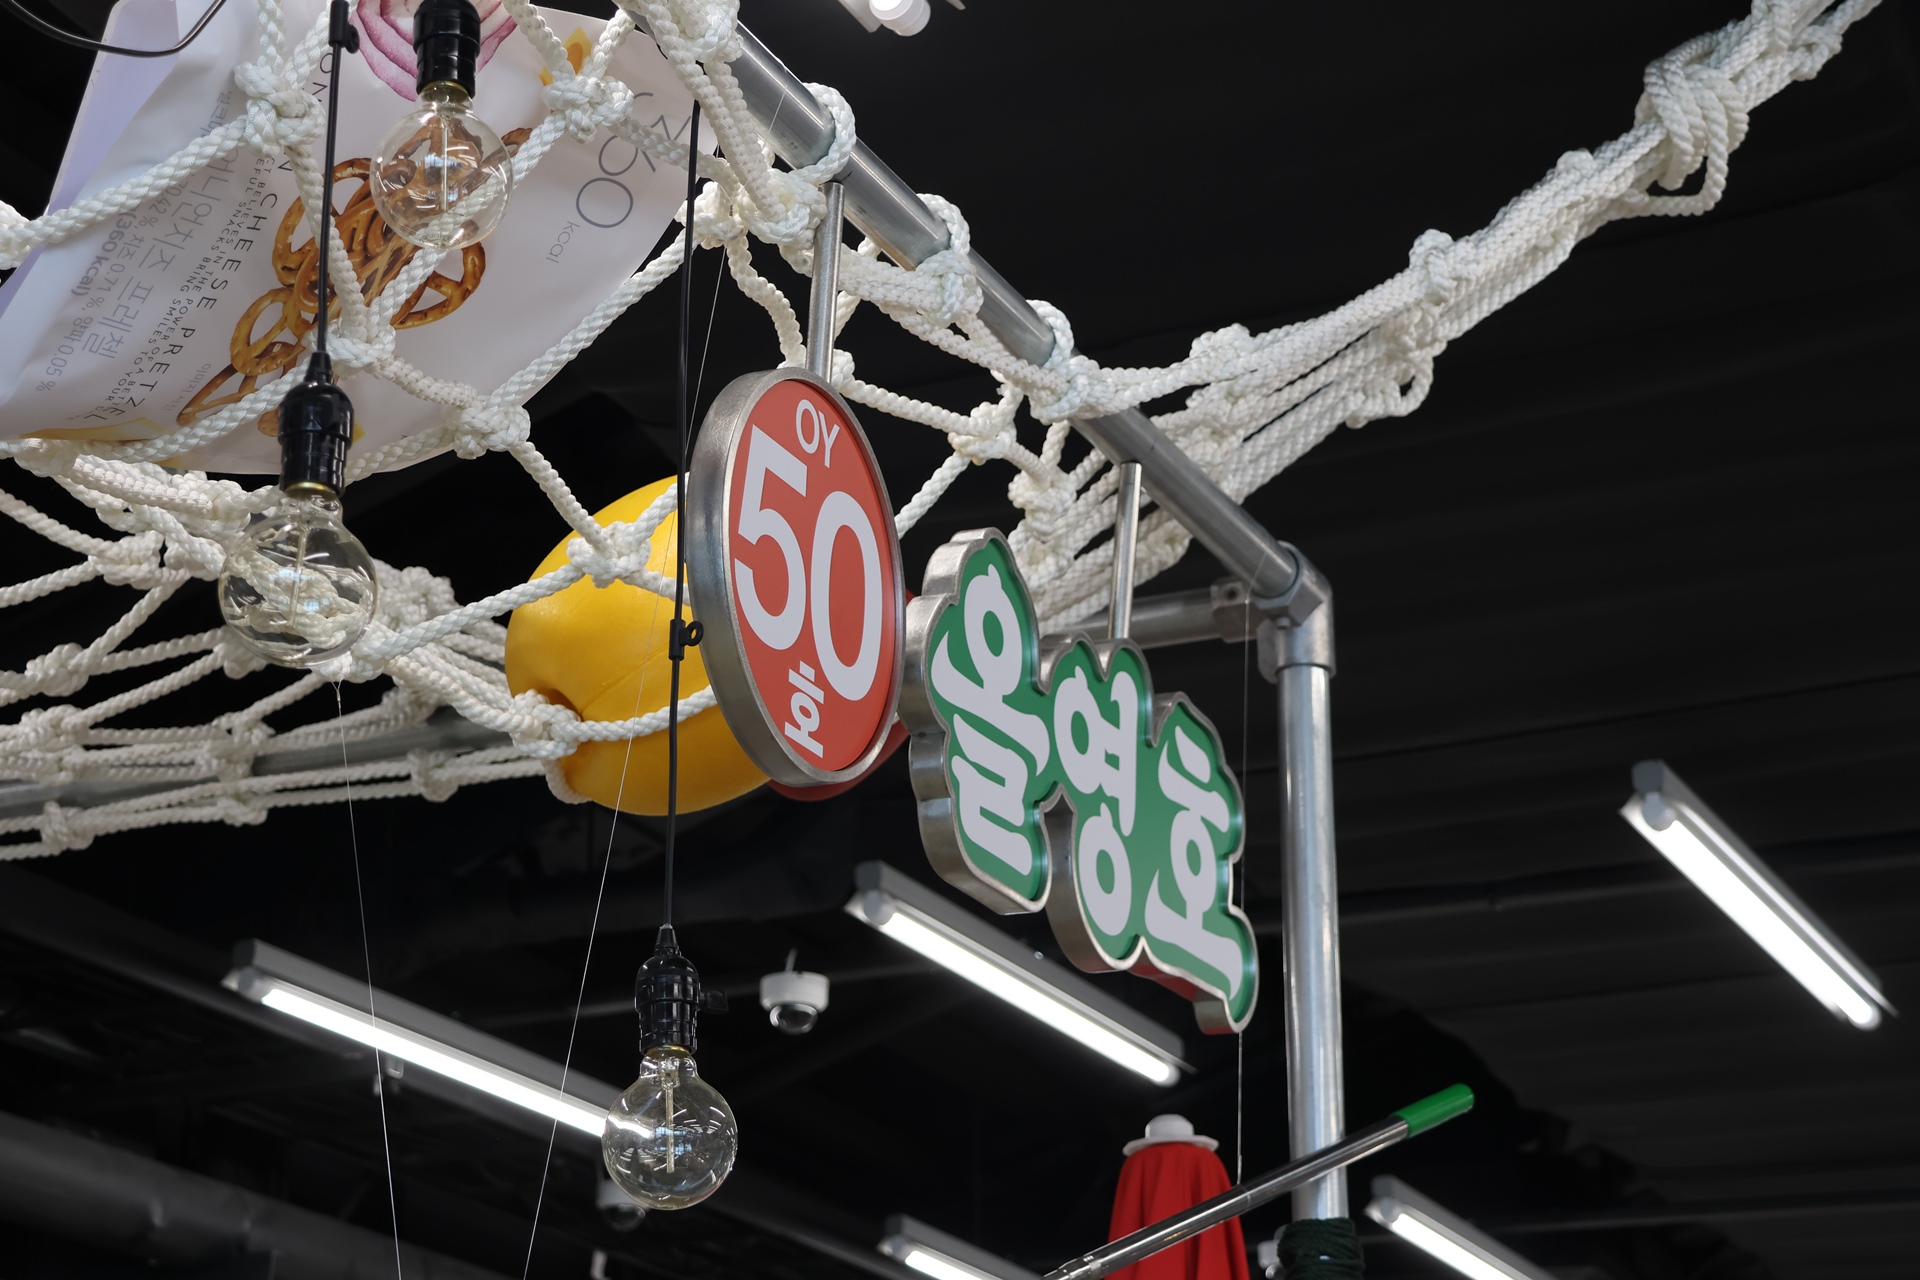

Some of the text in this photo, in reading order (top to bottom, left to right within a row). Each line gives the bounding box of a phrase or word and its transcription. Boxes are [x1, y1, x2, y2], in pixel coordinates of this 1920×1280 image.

[278, 53, 333, 171] ONN
[546, 92, 691, 263] 360 kcal
[139, 150, 239, 271] 어니언치즈
[211, 201, 247, 251] SNACKS
[226, 182, 266, 244] BELIEVES
[117, 234, 145, 260] 치즈
[197, 193, 278, 310] CHEESE
[213, 250, 227, 264] IN
[71, 256, 110, 297] kcal)
[97, 264, 125, 295] 0.71
[180, 256, 211, 292] BRING
[193, 270, 214, 293] THE
[64, 317, 93, 342] 양파
[81, 276, 154, 358] 프레첼
[148, 298, 181, 345] SMILES
[161, 298, 194, 341] POWER
[46, 344, 75, 377] 0.05
[84, 327, 196, 421] PRETZEL
[133, 349, 149, 366] TO
[136, 367, 145, 375] A
[146, 346, 161, 362] OF
[105, 371, 132, 404] YOUR
[795, 399, 840, 468] OY
[734, 424, 884, 701] 50
[784, 662, 826, 759] 호
[931, 563, 1240, 1000] 올영호
